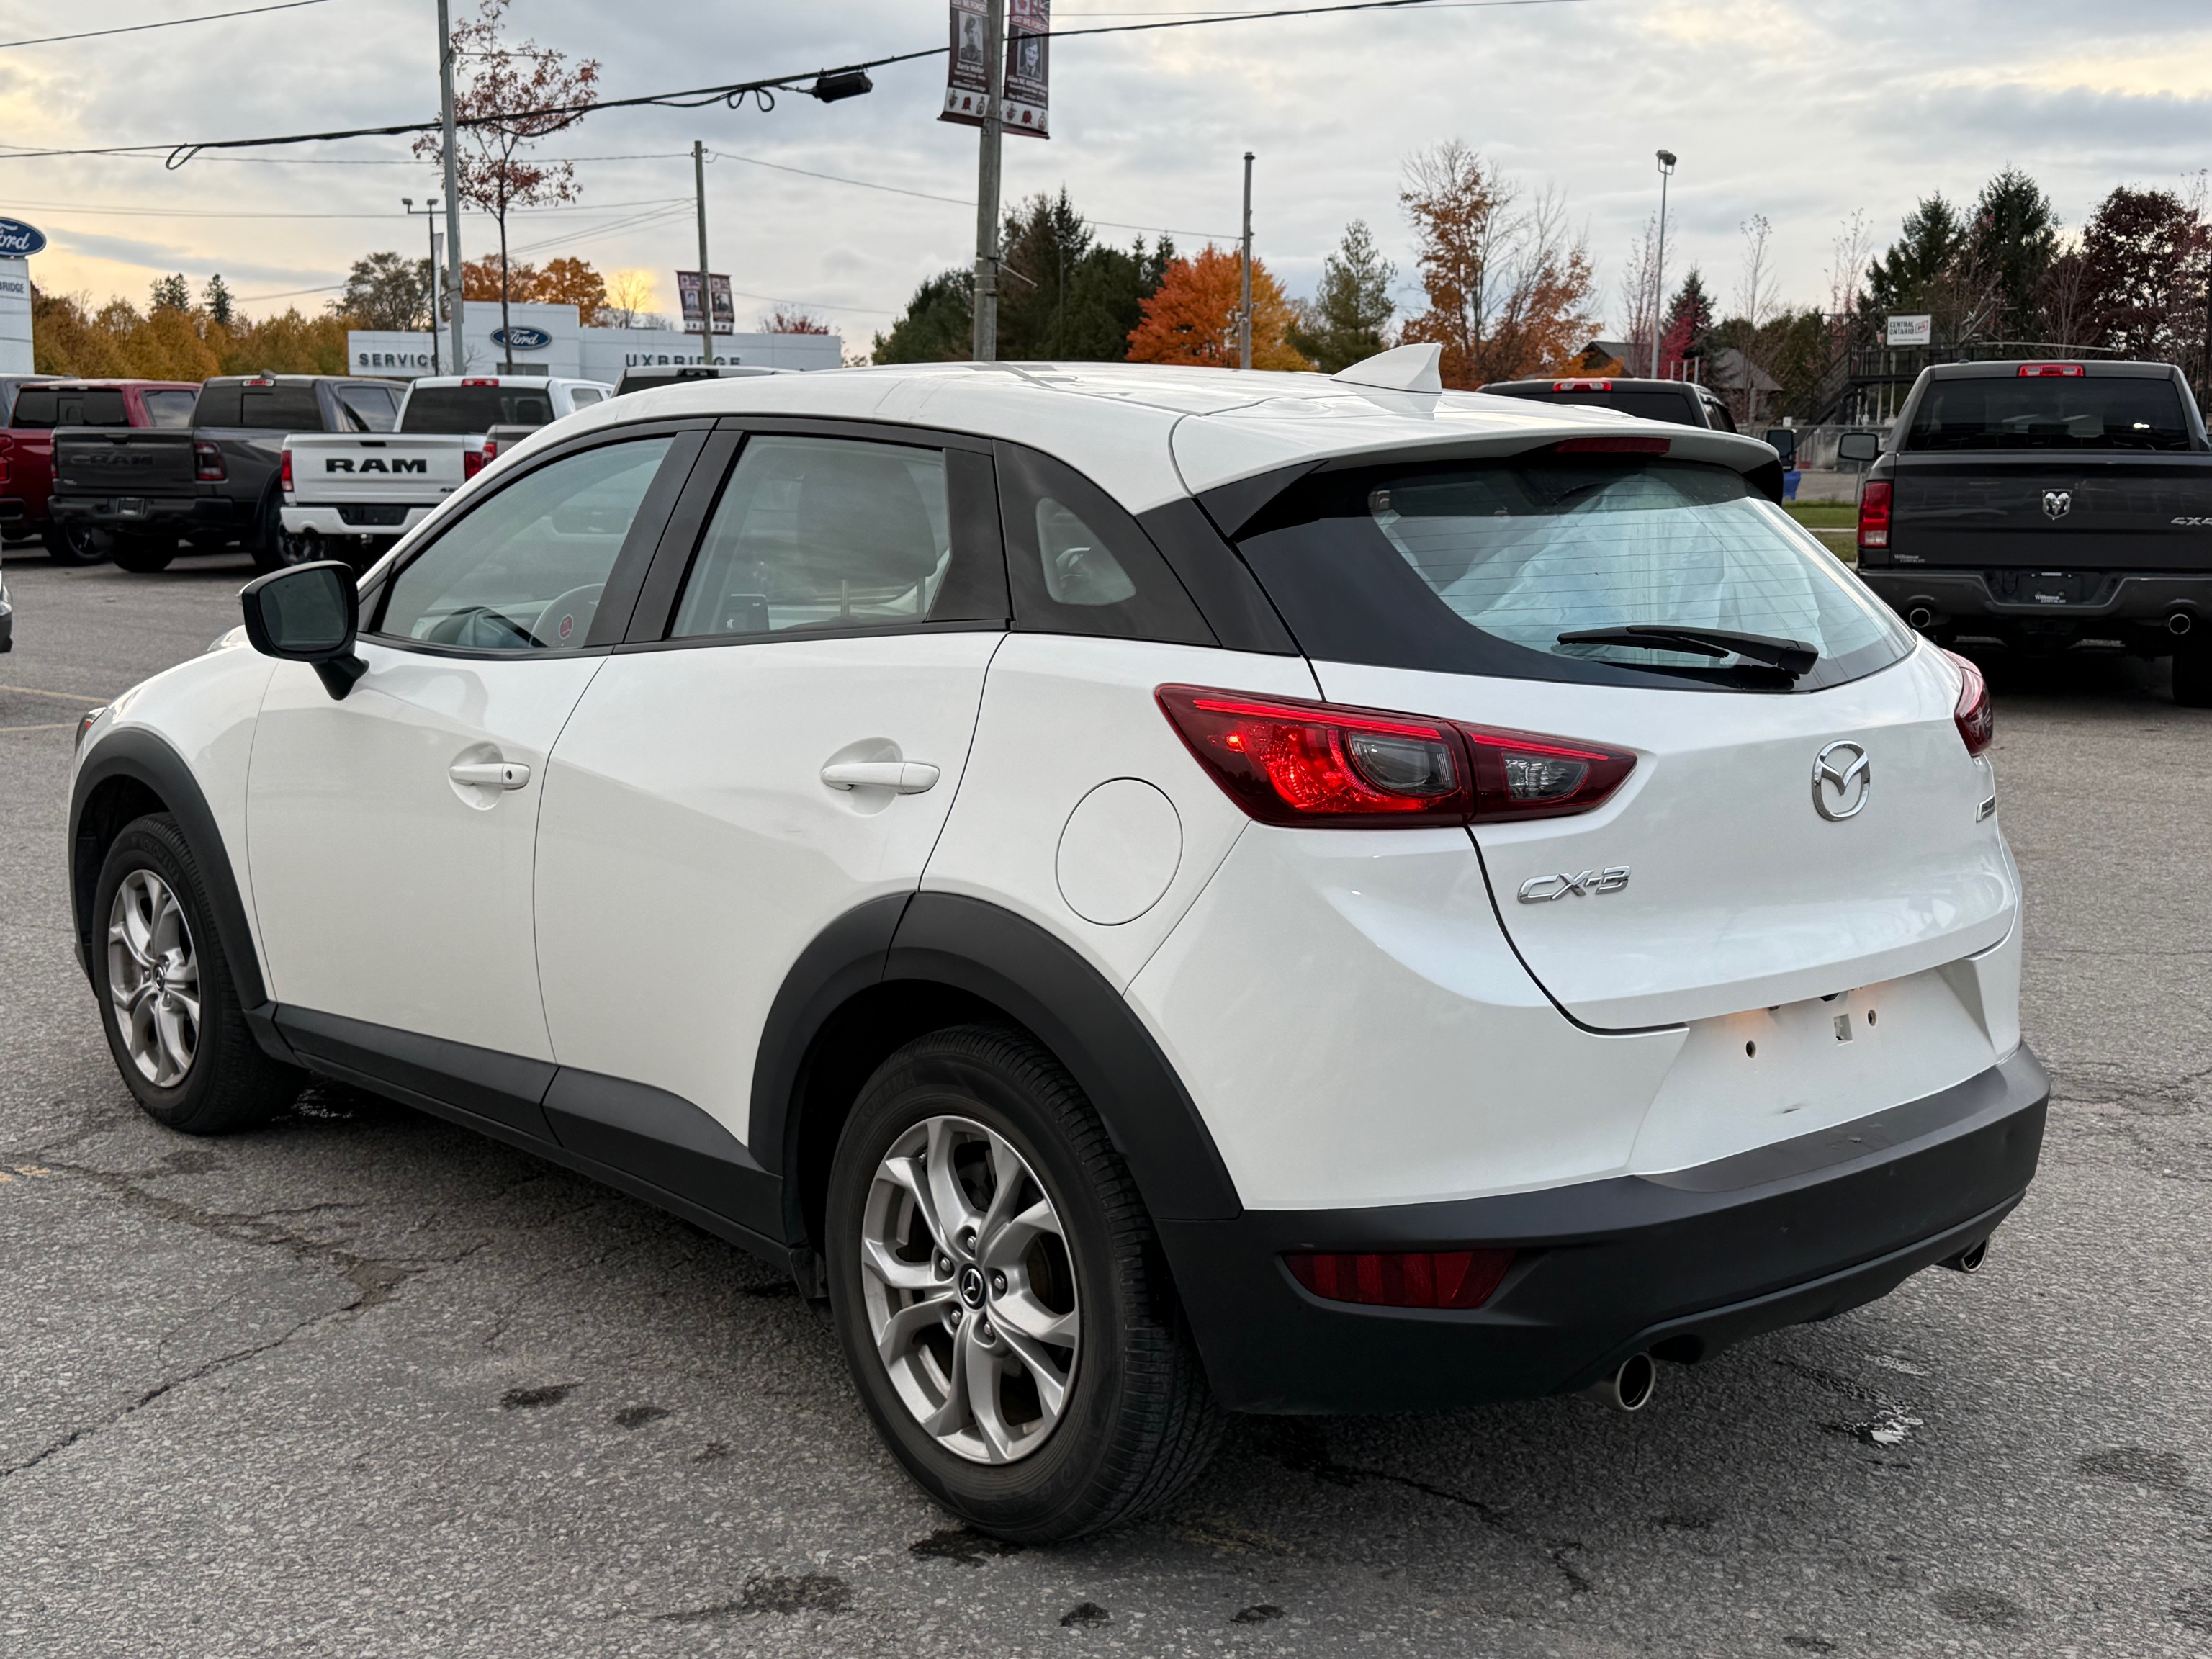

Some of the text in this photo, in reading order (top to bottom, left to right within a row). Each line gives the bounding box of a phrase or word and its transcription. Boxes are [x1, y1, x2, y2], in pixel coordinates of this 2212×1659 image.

[90, 455, 153, 465] RAM
[325, 458, 428, 473] RAM
[1517, 865, 1631, 904] CX-3
